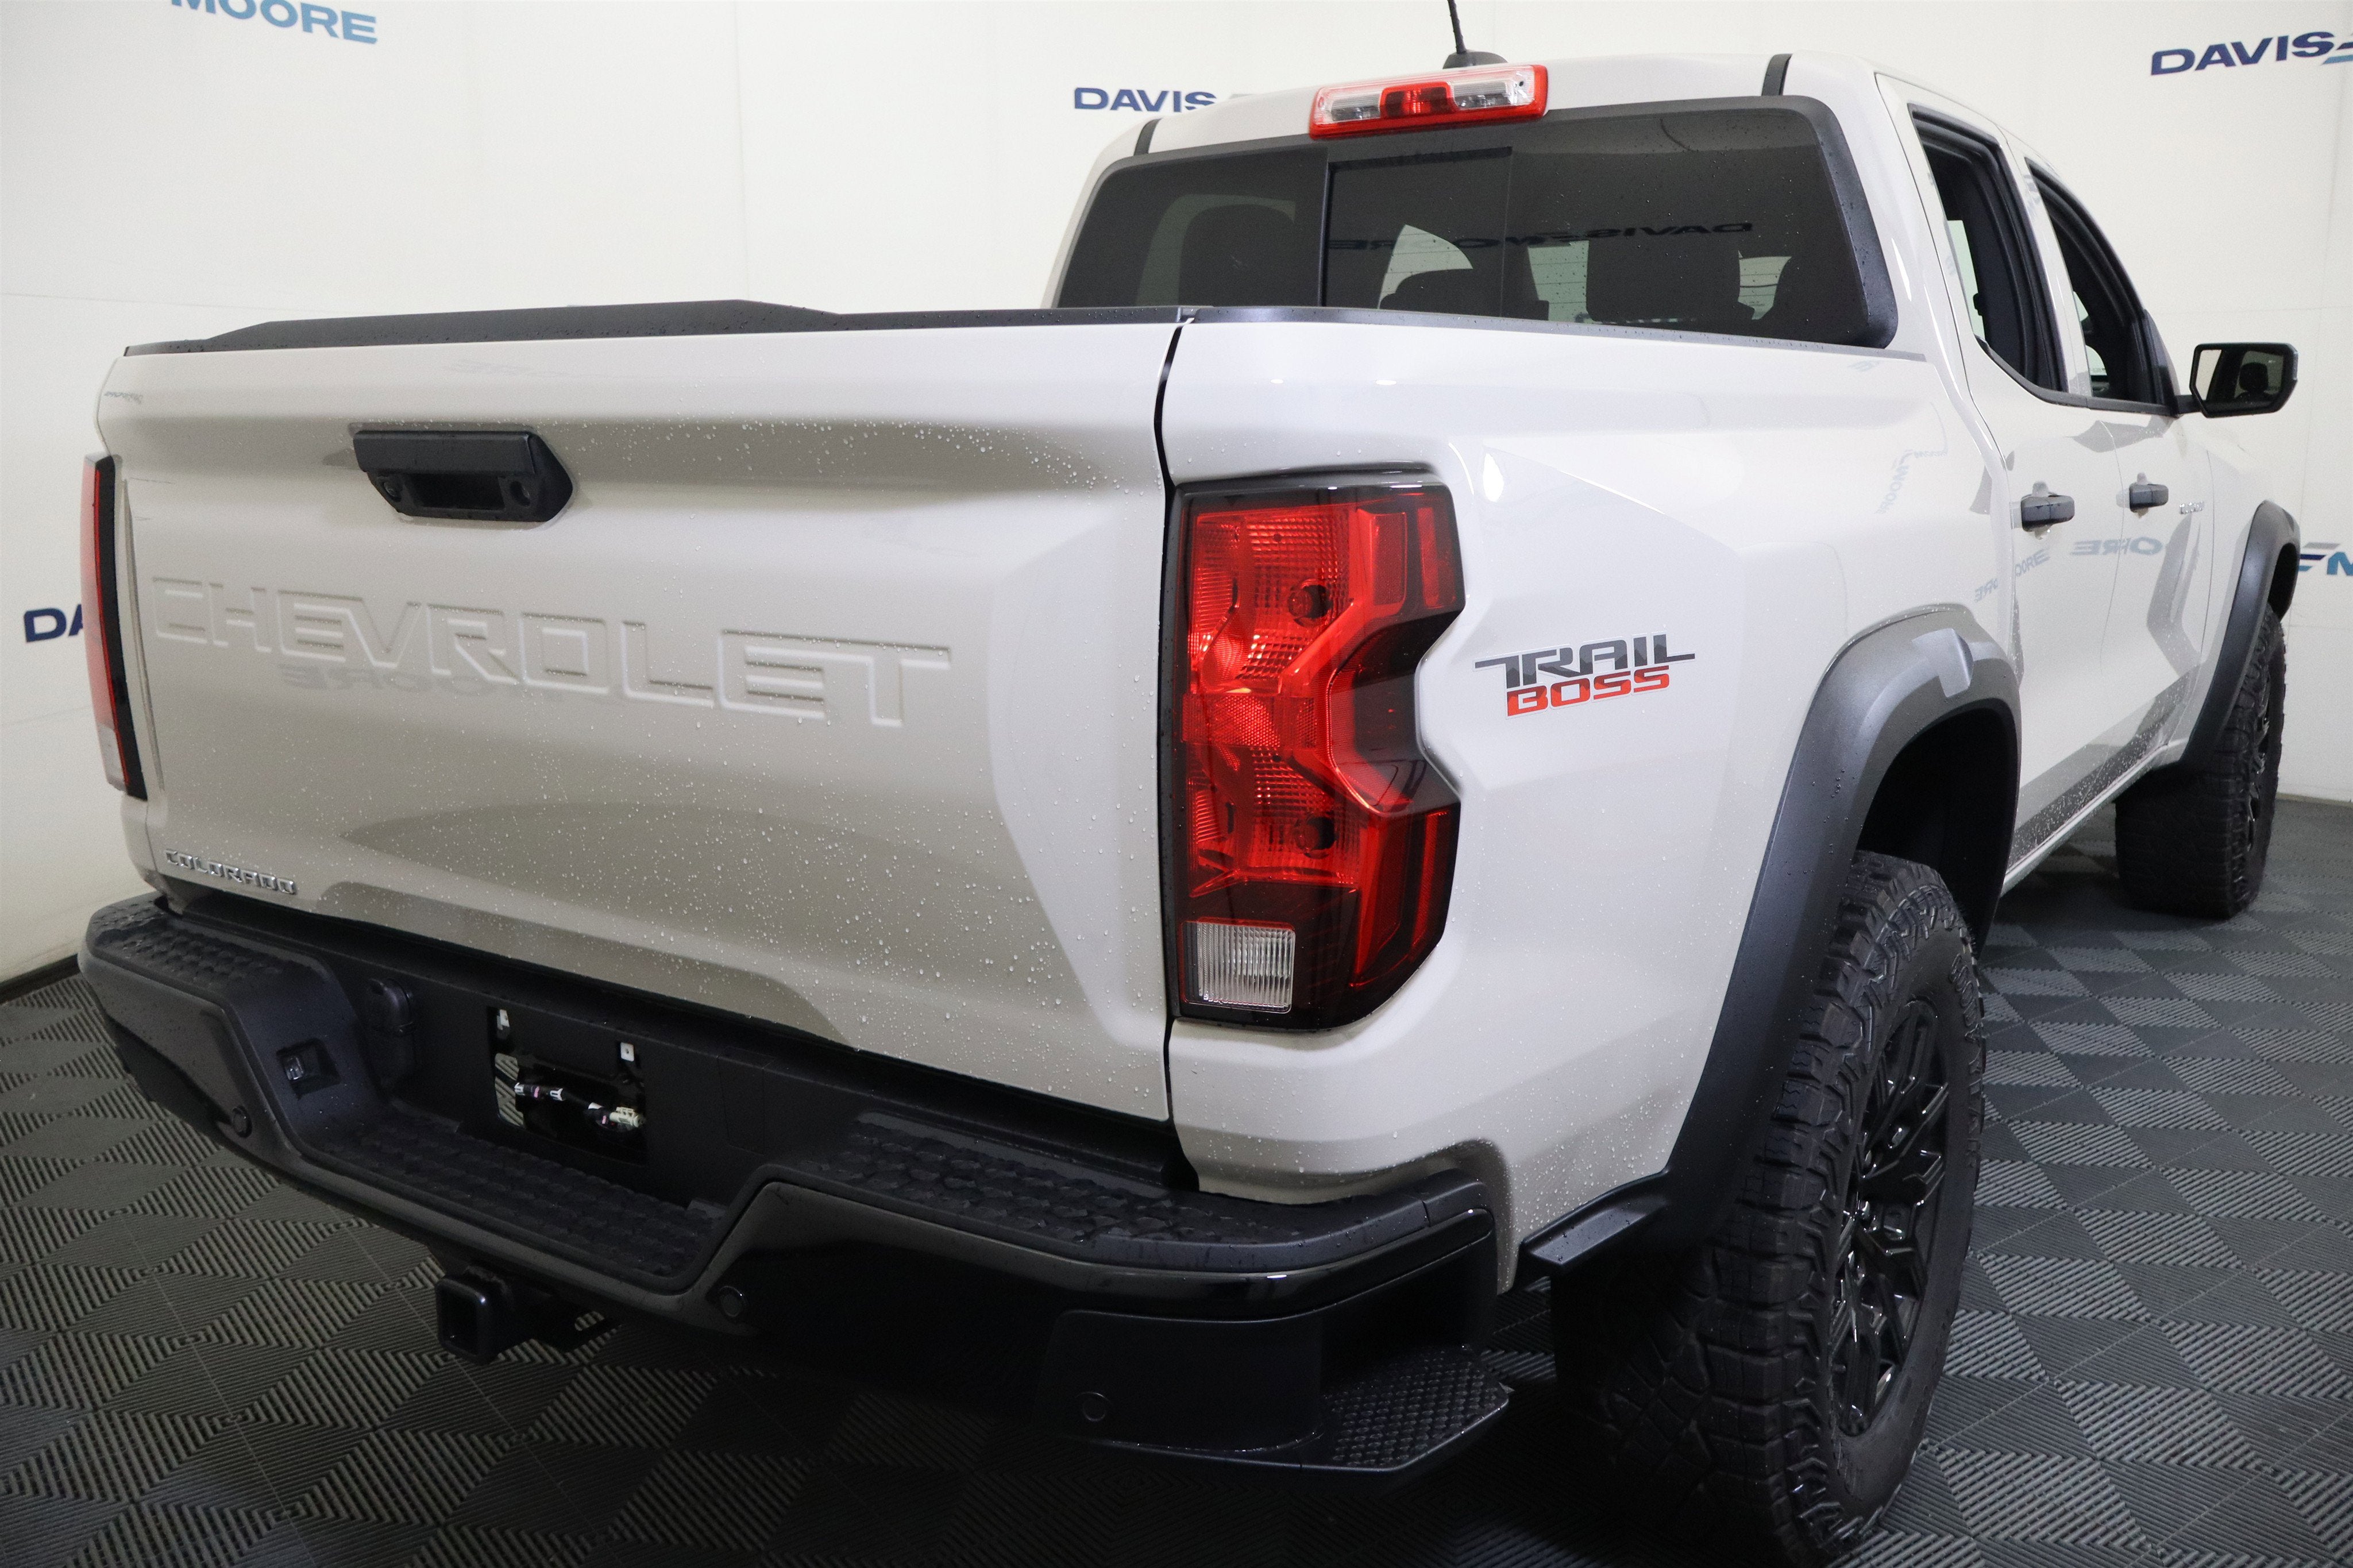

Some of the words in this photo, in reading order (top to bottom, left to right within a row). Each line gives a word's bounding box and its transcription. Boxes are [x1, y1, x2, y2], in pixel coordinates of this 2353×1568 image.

[2151, 32, 2335, 75] DAVIS
[1074, 87, 1217, 112] DAVIS
[152, 576, 951, 727] CHEVROLET
[1475, 634, 1695, 689] TRAIL
[1507, 665, 1669, 717] BOSS
[164, 849, 297, 895] COLORADO
